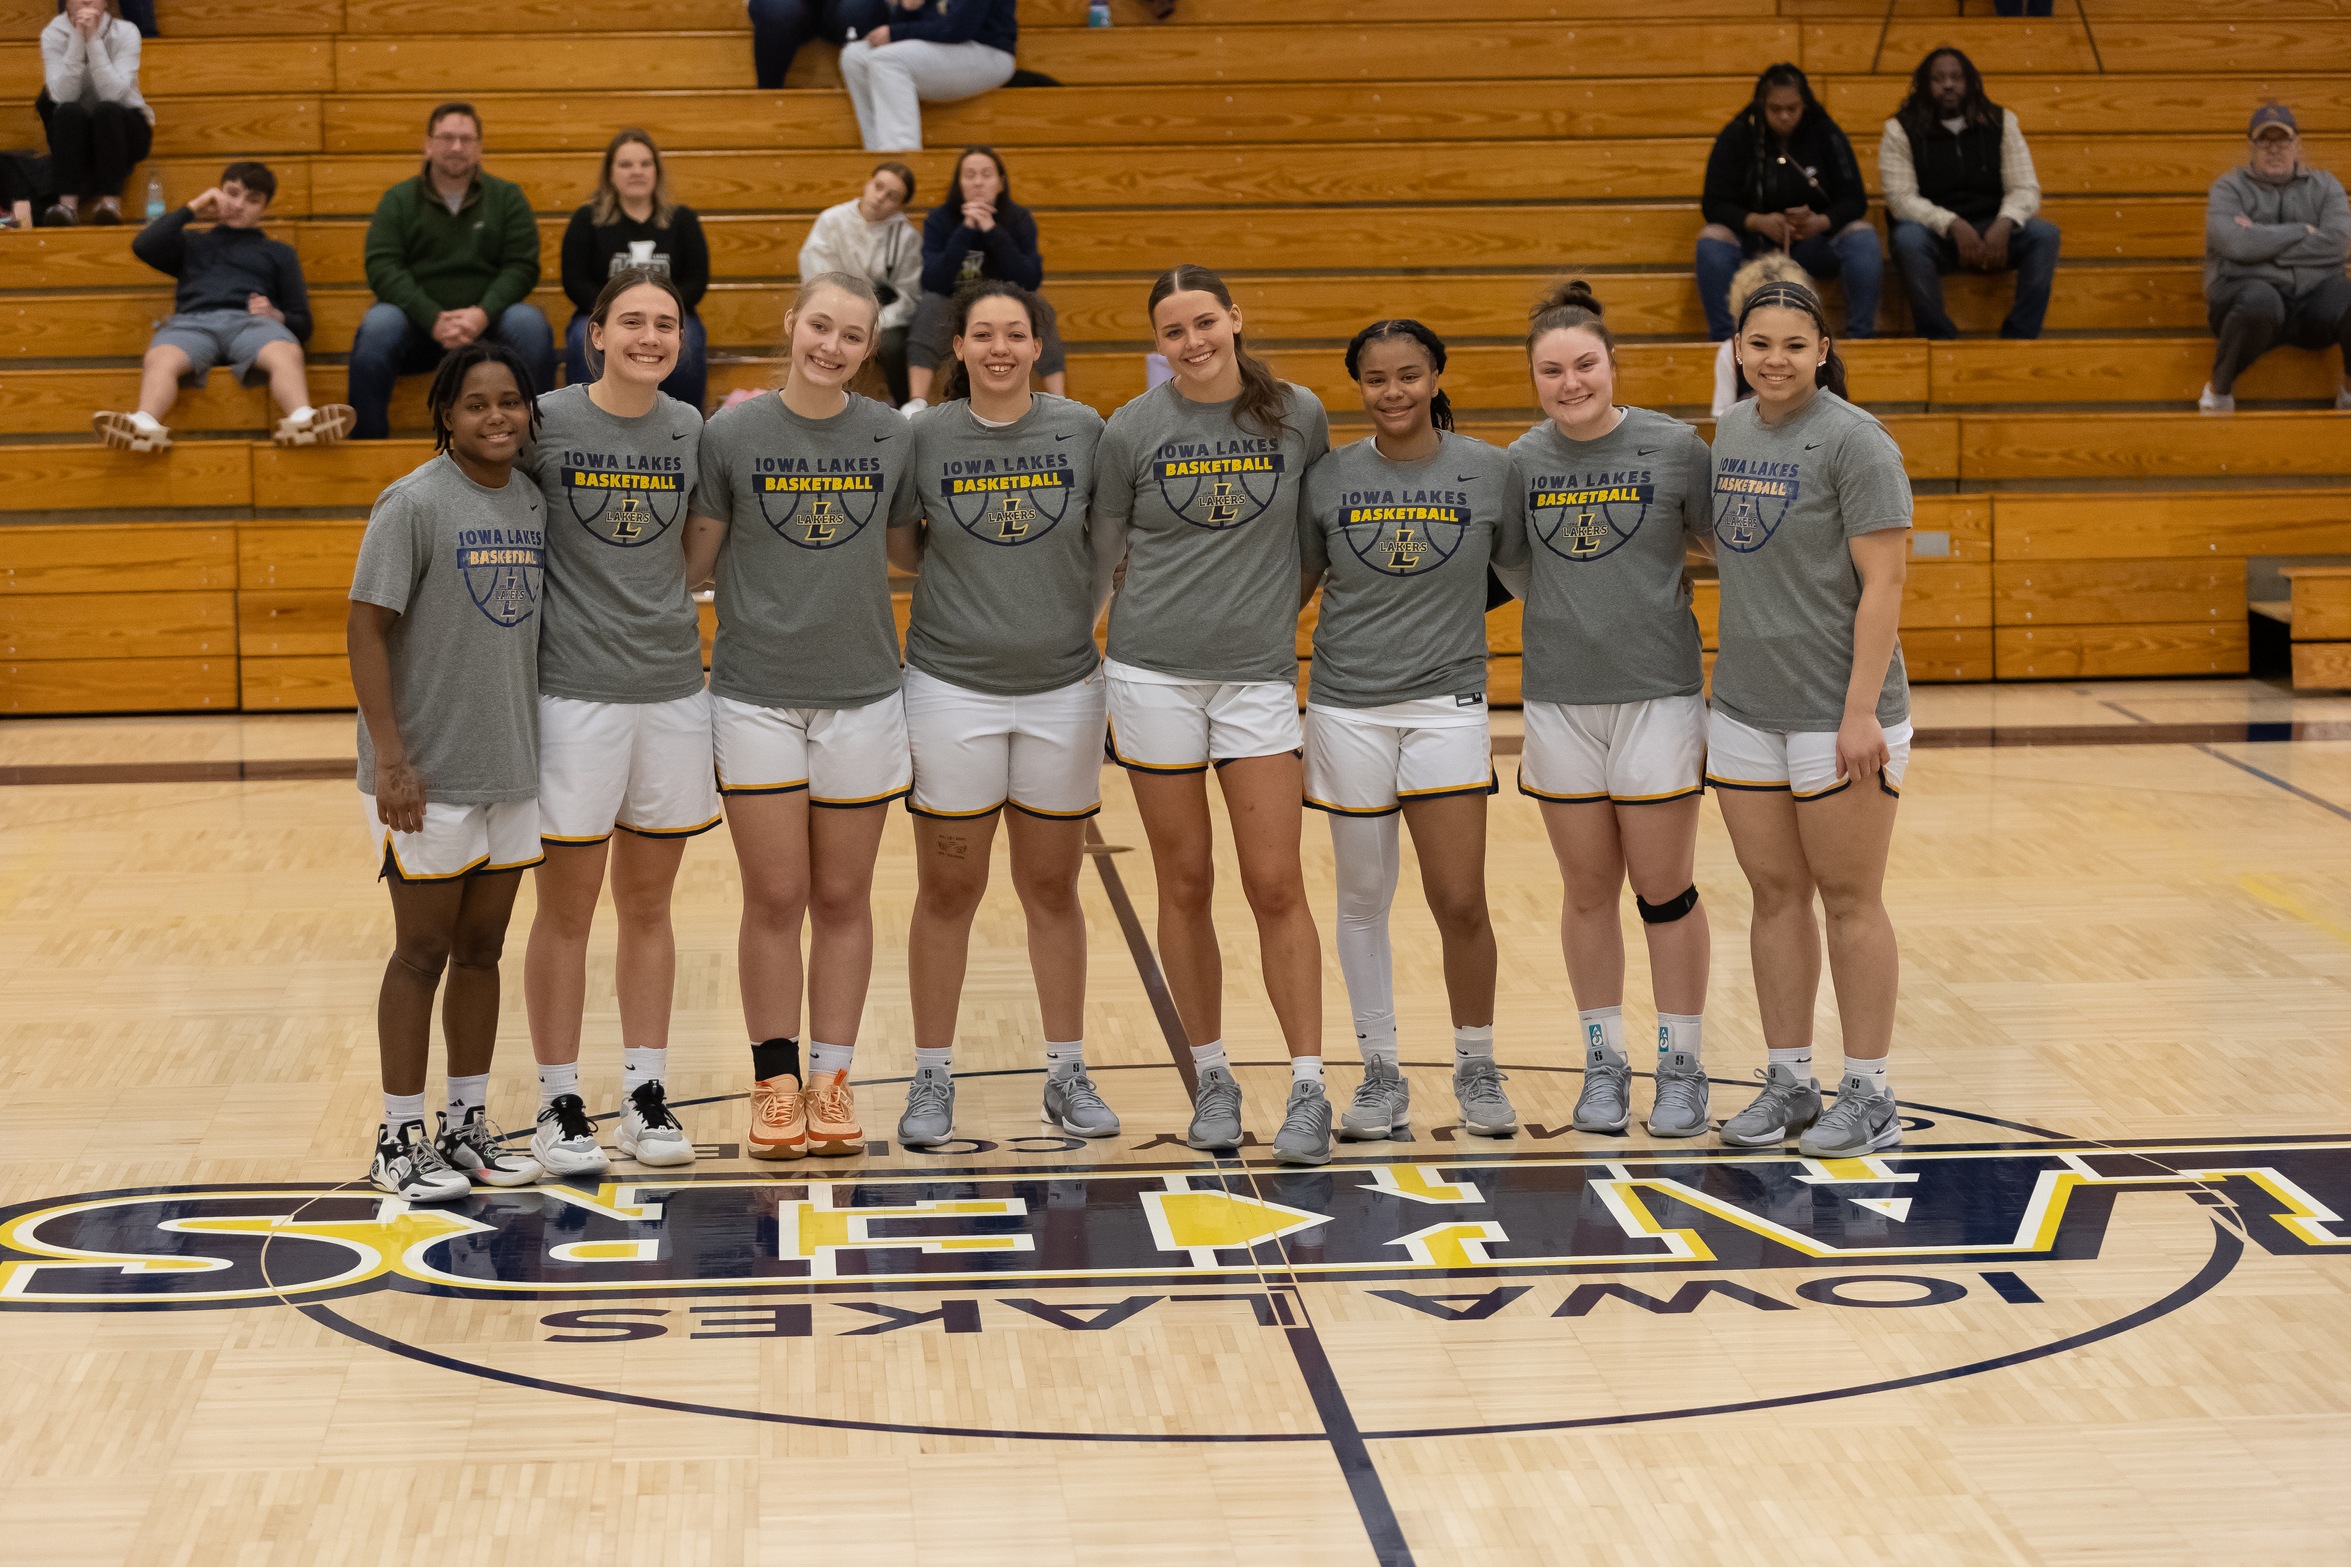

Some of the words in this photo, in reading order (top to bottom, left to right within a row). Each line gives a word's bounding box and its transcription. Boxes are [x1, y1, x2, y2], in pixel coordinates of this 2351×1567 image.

[1157, 443, 1209, 459] IOWA
[1216, 438, 1279, 455] LAKES
[564, 451, 619, 469] IOWA
[626, 455, 682, 471] LAKES
[755, 457, 809, 472] IOWA
[817, 457, 880, 472] LAKES
[943, 459, 996, 476] IOWA
[1004, 453, 1068, 471] LAKES
[1165, 457, 1273, 476] BASKETBALL
[1719, 458, 1747, 473] IOWA
[1749, 460, 1799, 478] LAKES
[574, 472, 676, 489] BASKETBALL
[765, 476, 873, 491] BASKETBALL
[953, 472, 1062, 493] BASKETBALL
[1531, 474, 1578, 489] IOWA
[1586, 470, 1651, 487] LAKES
[1199, 494, 1246, 507] LAKERS
[1342, 490, 1394, 506] IOWA
[1402, 490, 1468, 505] LAKES
[1537, 488, 1641, 507] BASKETBALL
[605, 511, 650, 523] LAKERS
[797, 514, 844, 525] LAKERS
[988, 509, 1036, 523] LAKERS
[1350, 507, 1459, 522] BASKETBALL
[459, 529, 503, 546] IOWA
[507, 529, 542, 546] LAKES
[1562, 524, 1608, 537] LAKERS
[1380, 541, 1428, 552] LAKERS
[1364, 1271, 2045, 1321] IOWA
[538, 1292, 1286, 1342] LAKES
